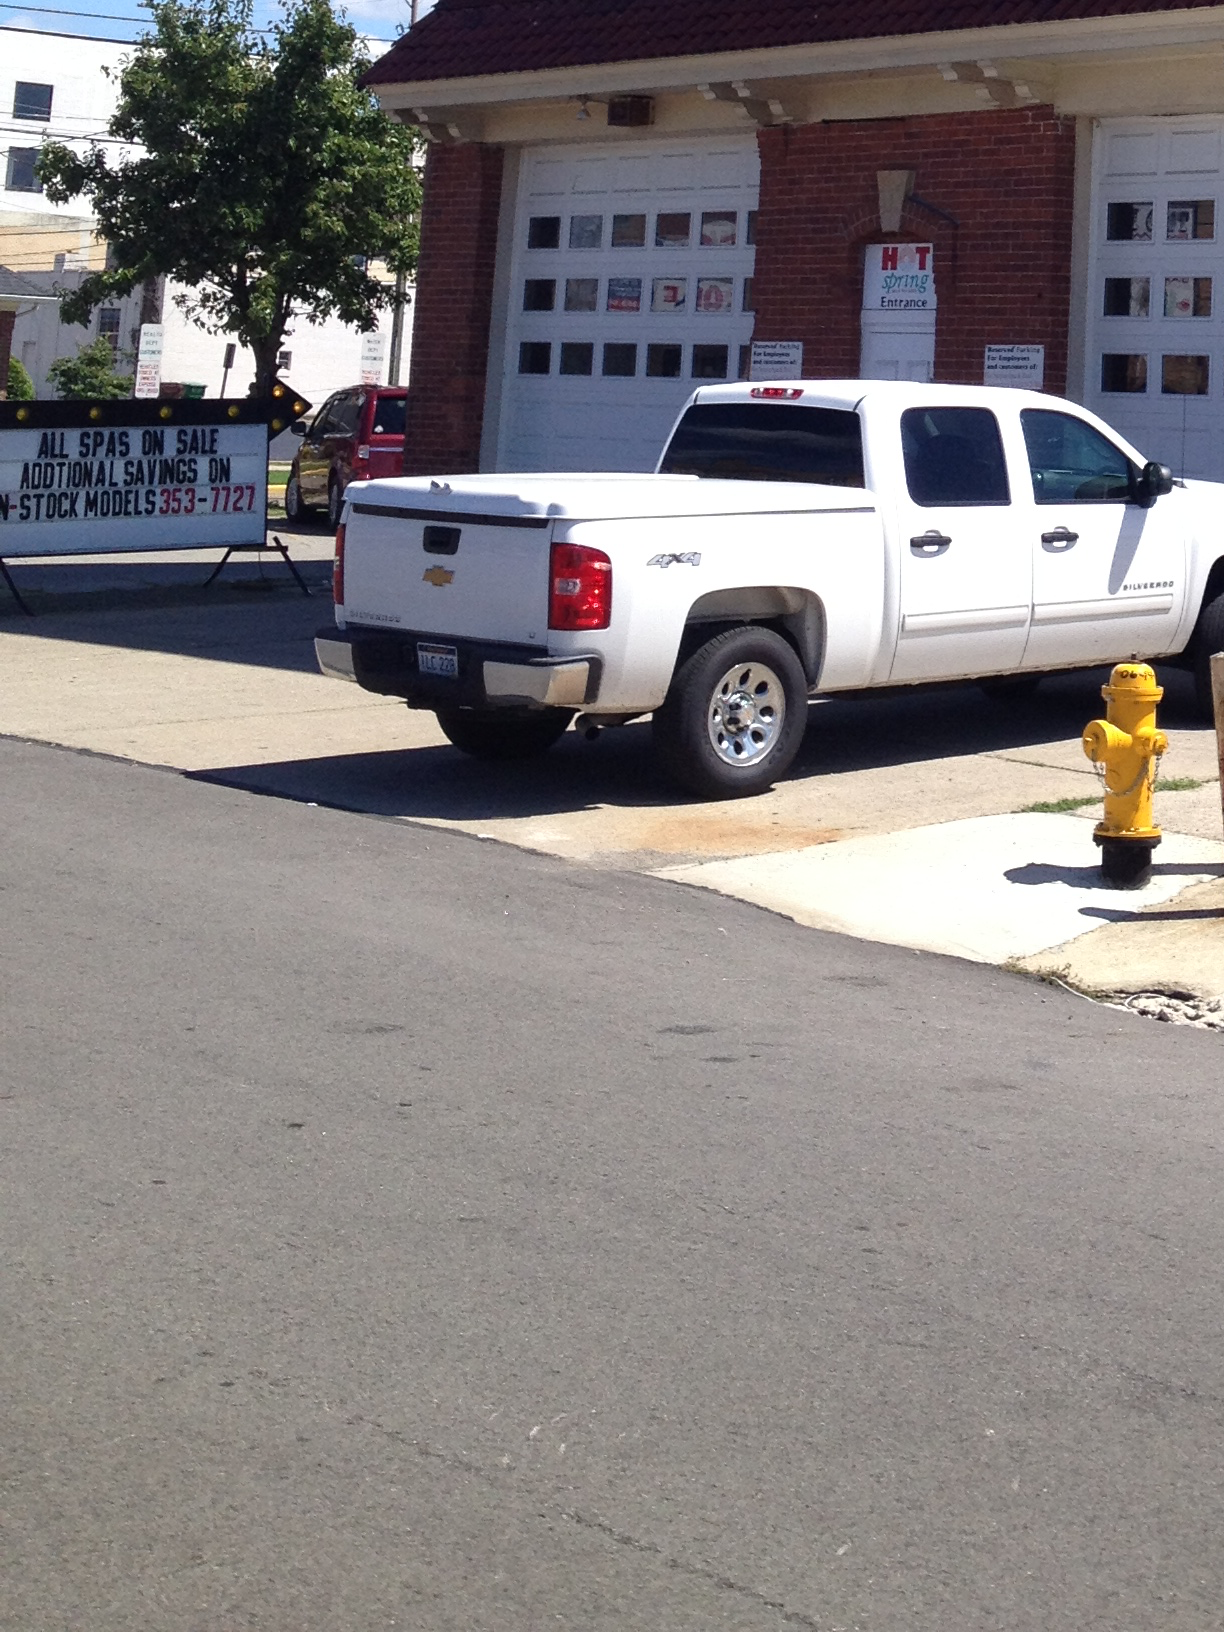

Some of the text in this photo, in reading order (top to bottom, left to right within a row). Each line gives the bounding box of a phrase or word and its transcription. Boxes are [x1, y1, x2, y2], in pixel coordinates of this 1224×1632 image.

[882, 272, 930, 294] spring
[880, 296, 928, 308] Entrance
[37, 428, 219, 459] ALL SPAS ON SALE
[20, 456, 231, 490] ADDTIONAL SAVINGS ON
[84, 488, 157, 518] MODELS
[158, 484, 256, 515] 353-7727
